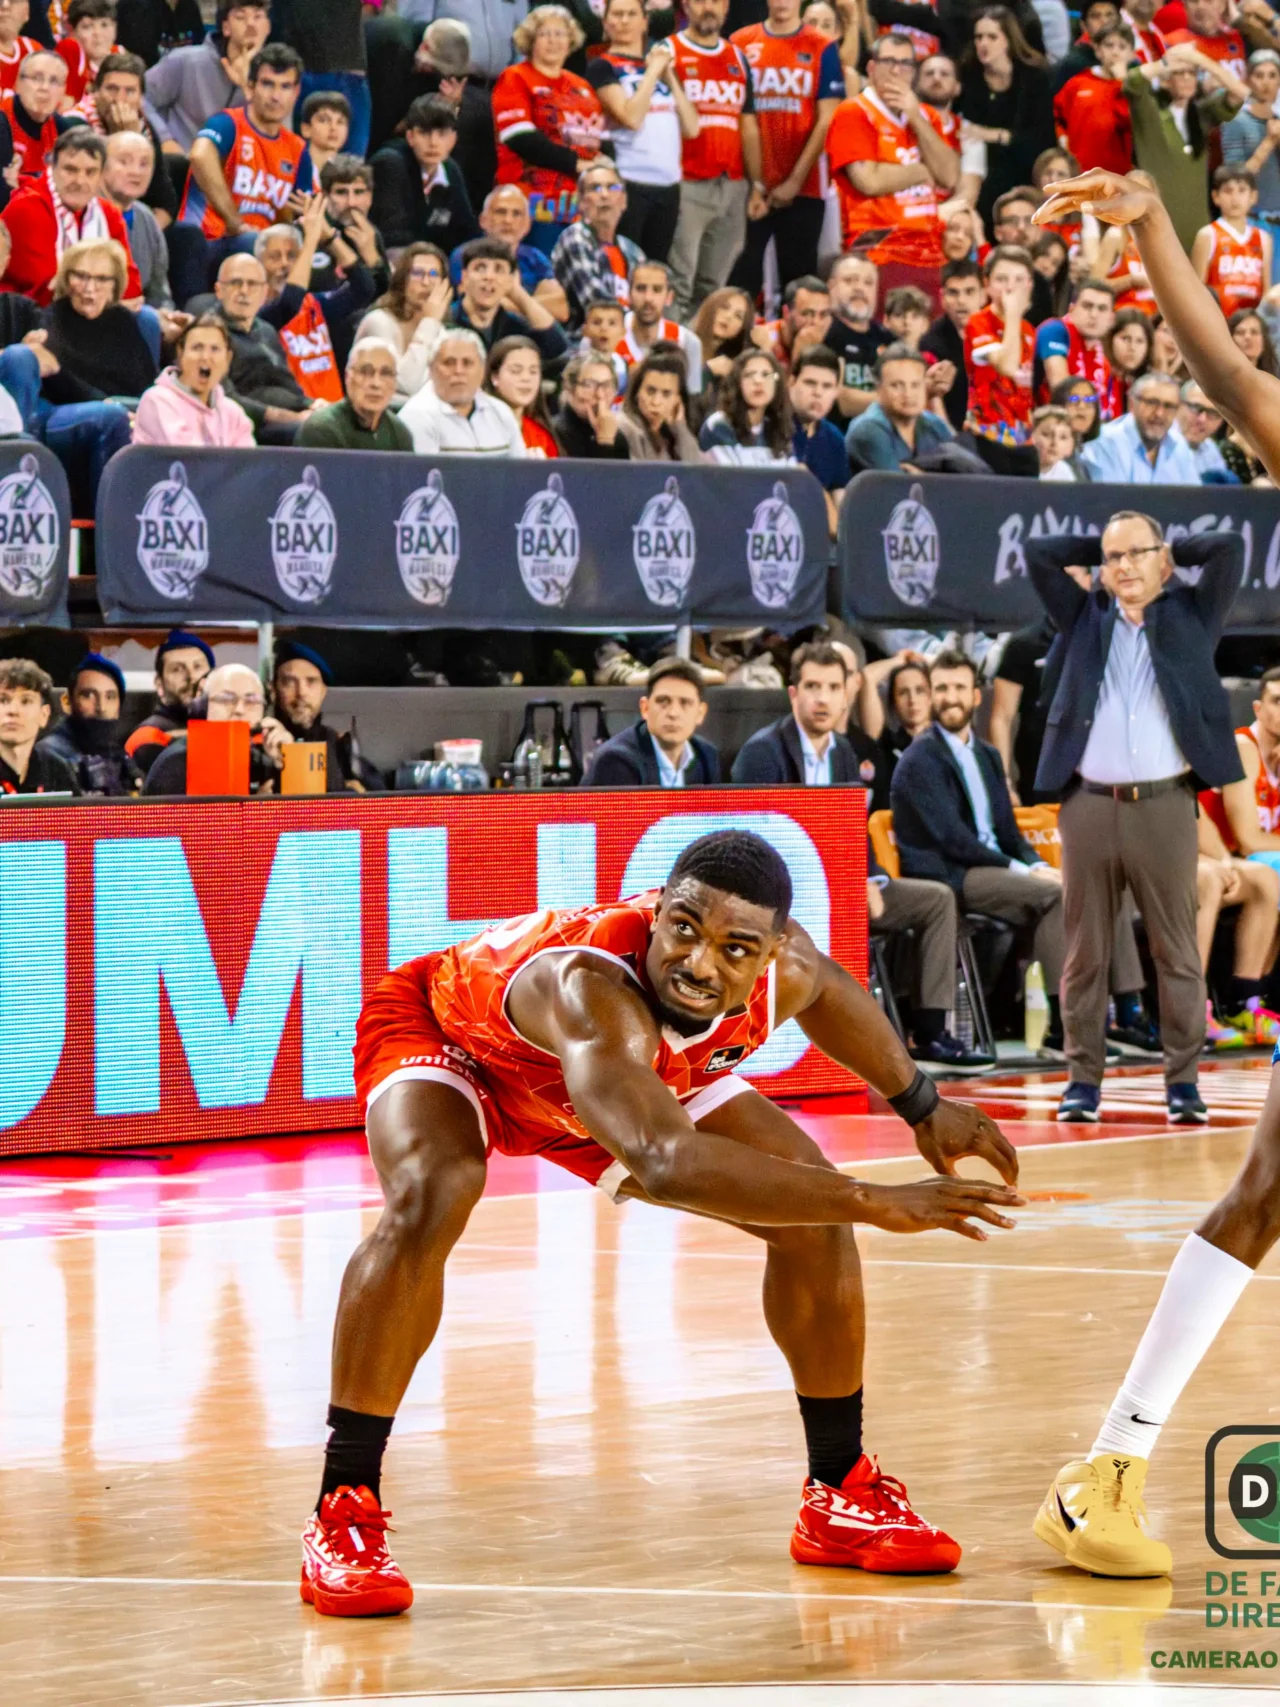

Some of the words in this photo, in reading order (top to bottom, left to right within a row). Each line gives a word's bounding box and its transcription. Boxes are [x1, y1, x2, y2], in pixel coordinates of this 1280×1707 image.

[684, 79, 747, 105] BAXI
[143, 519, 205, 551] BAXI
[275, 521, 333, 554] BAXI
[400, 524, 456, 556] BAXI
[521, 527, 576, 557] BAXI
[638, 529, 691, 559] BAXI
[751, 533, 800, 562] BAXI
[887, 533, 936, 562] BAXI
